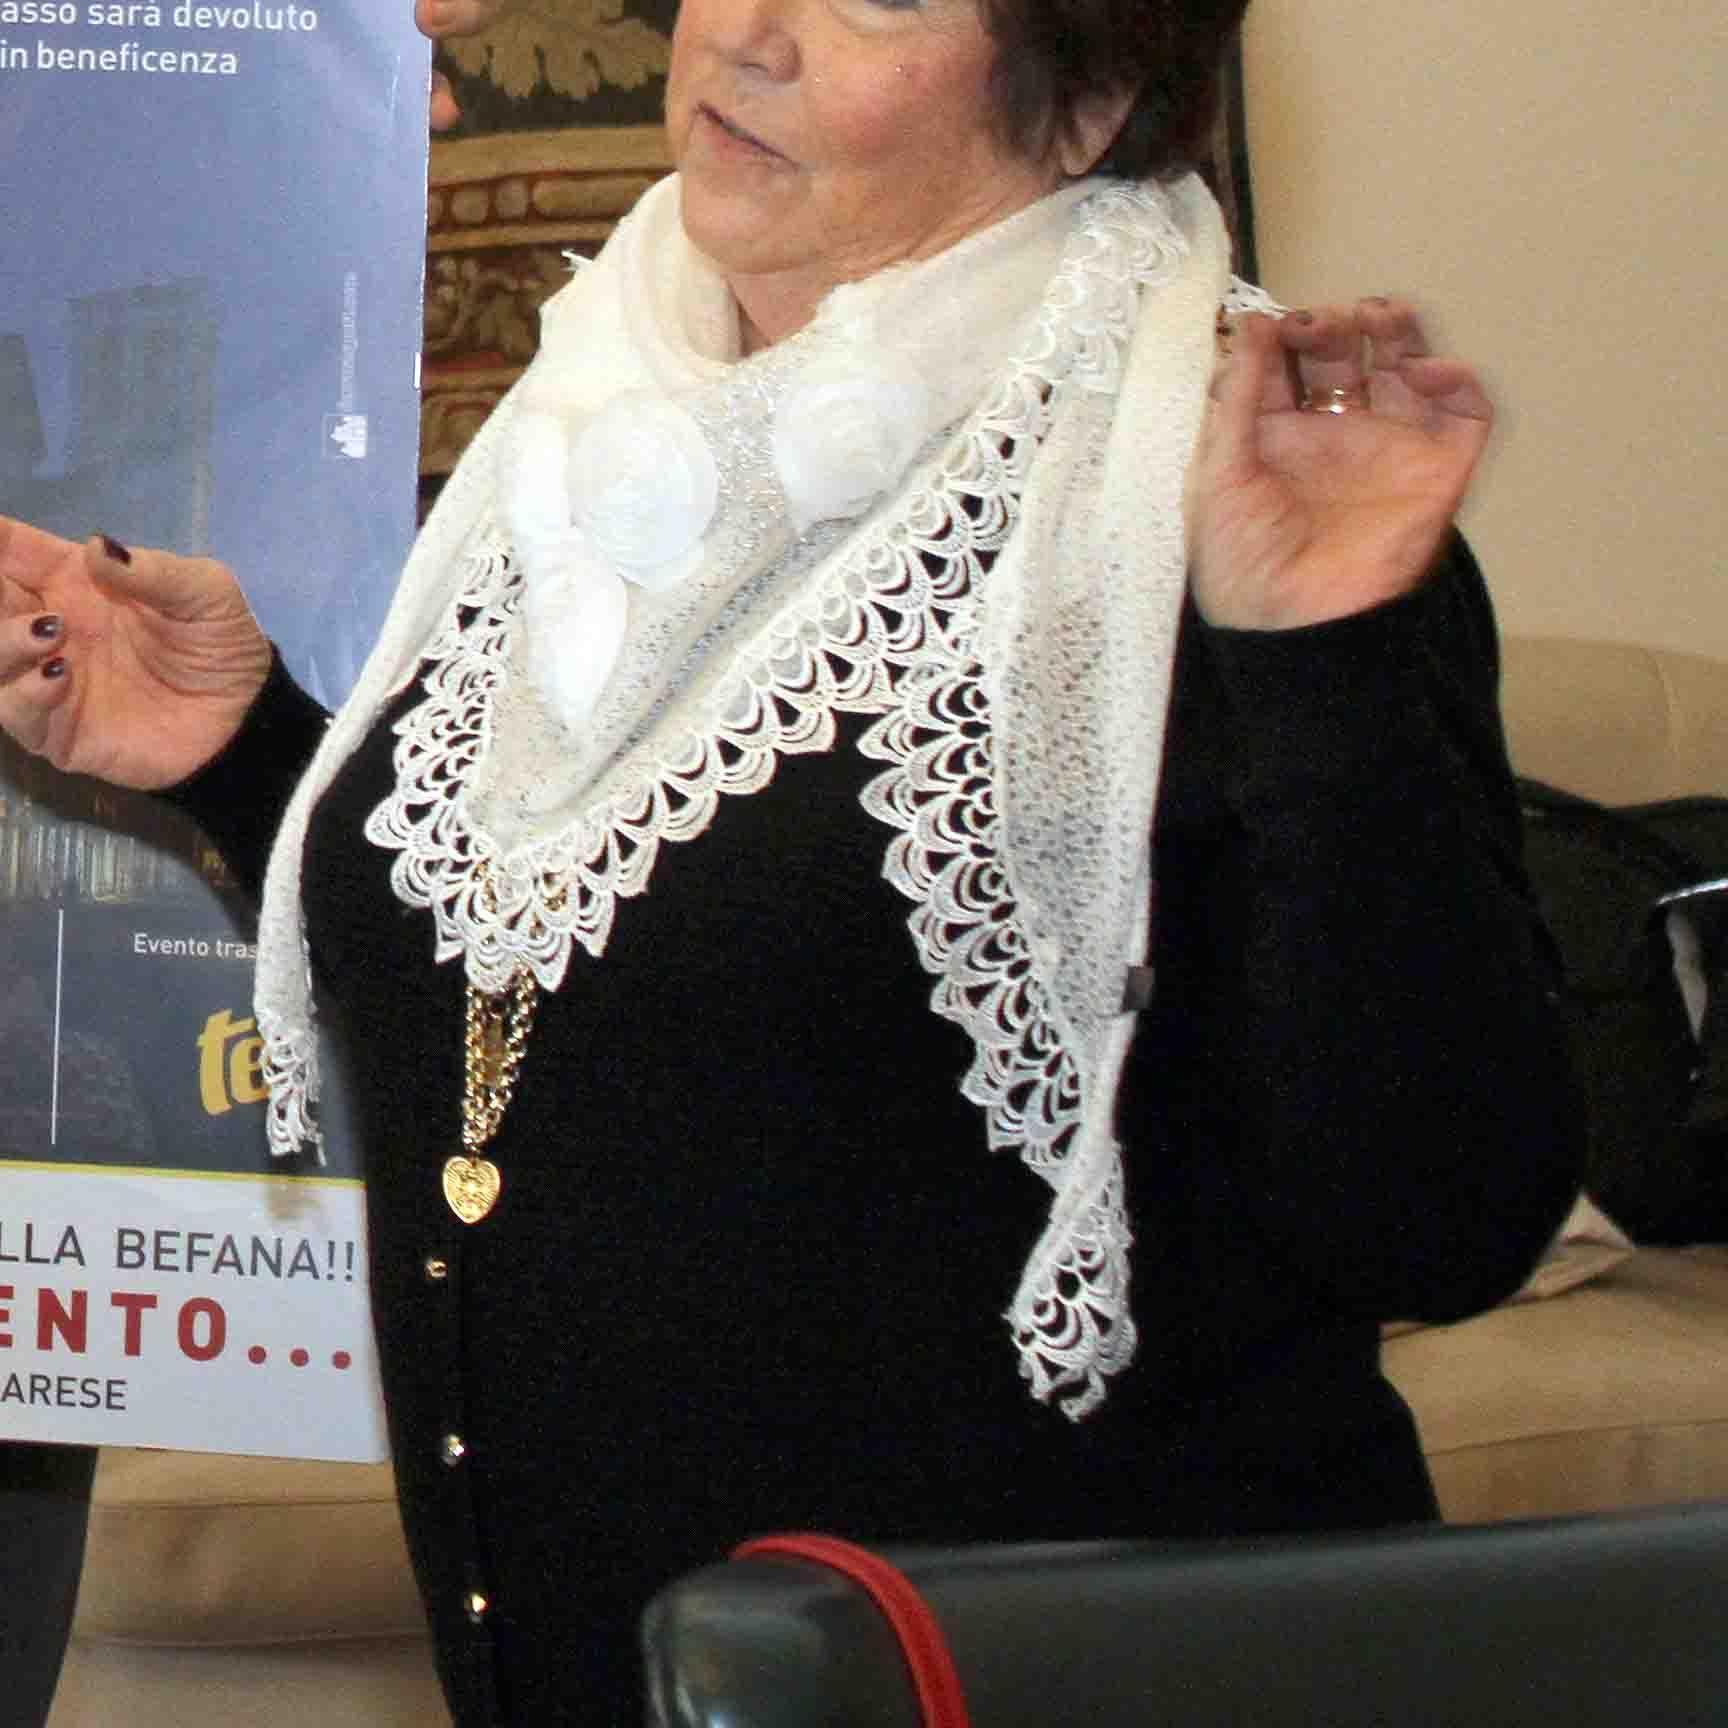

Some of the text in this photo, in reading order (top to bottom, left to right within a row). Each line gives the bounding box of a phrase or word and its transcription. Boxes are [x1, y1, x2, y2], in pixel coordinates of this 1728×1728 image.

[0, 40, 239, 75] in beneficenza
[133, 932, 259, 959] Evento tras
[116, 1228, 356, 1283] BEFANA!!
